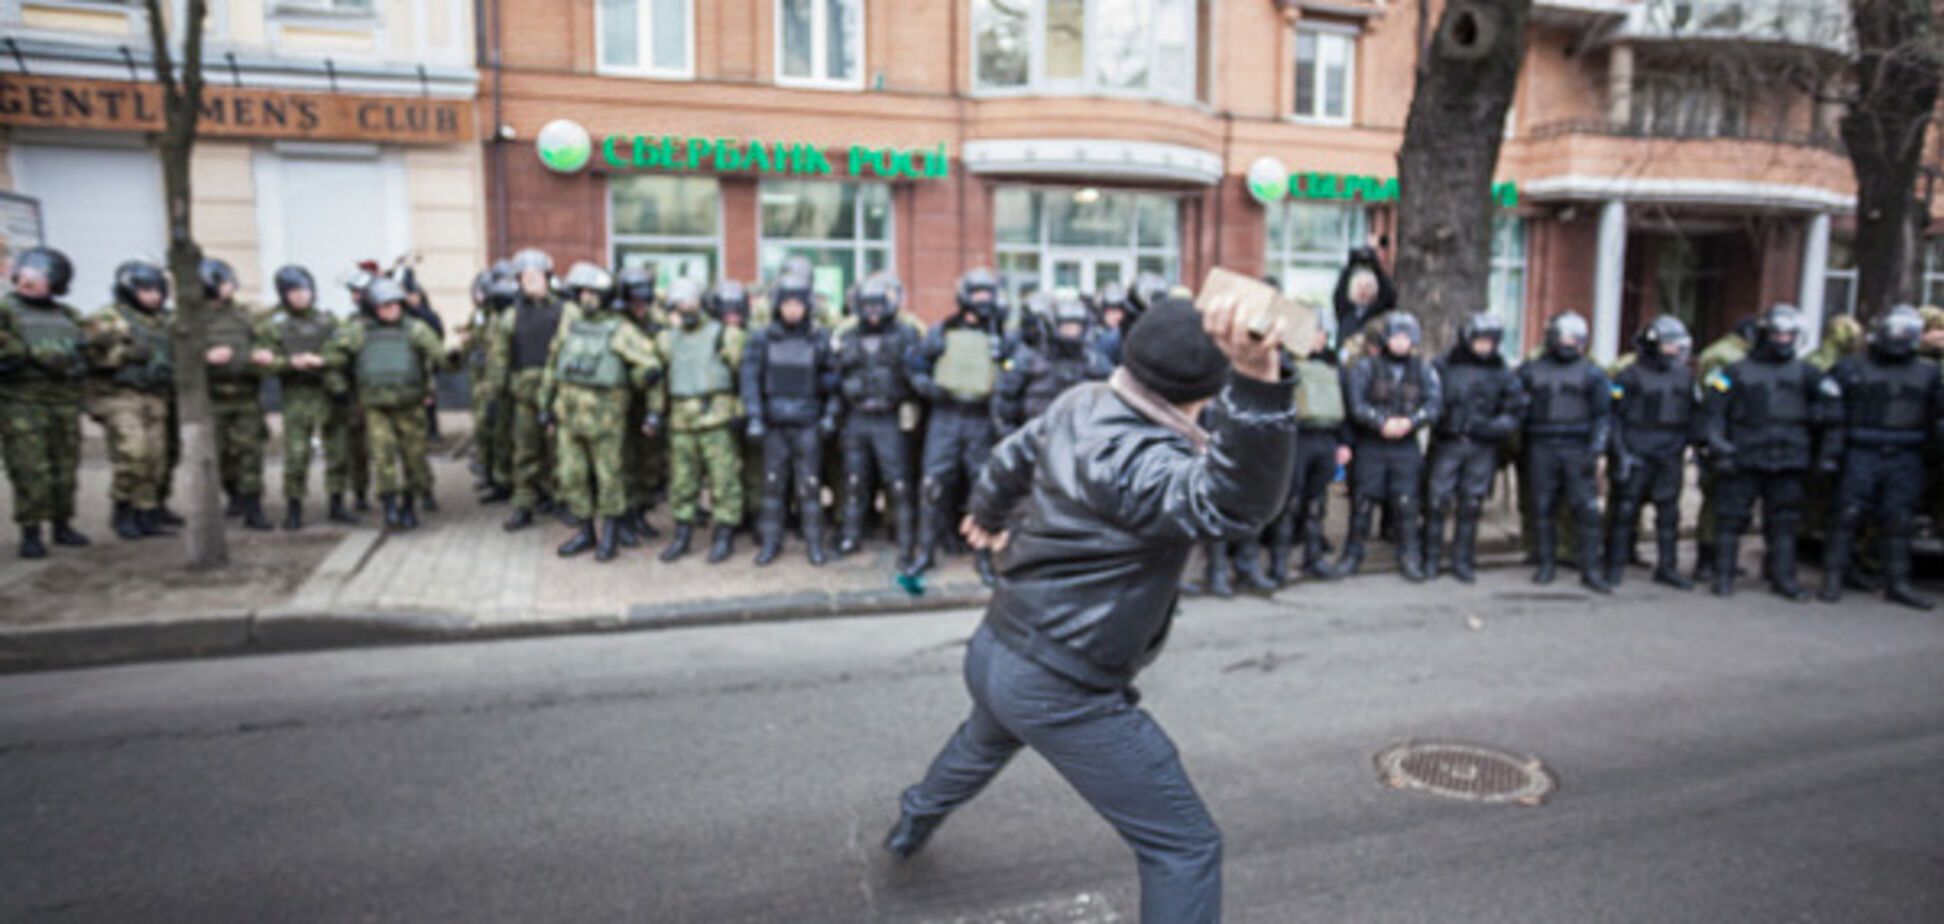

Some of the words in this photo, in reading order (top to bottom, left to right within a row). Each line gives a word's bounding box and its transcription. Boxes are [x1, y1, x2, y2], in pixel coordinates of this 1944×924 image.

[0, 82, 319, 130] GENTLMEN'S
[357, 101, 458, 133] CLUB
[602, 134, 824, 174] СБЕРБАНК
